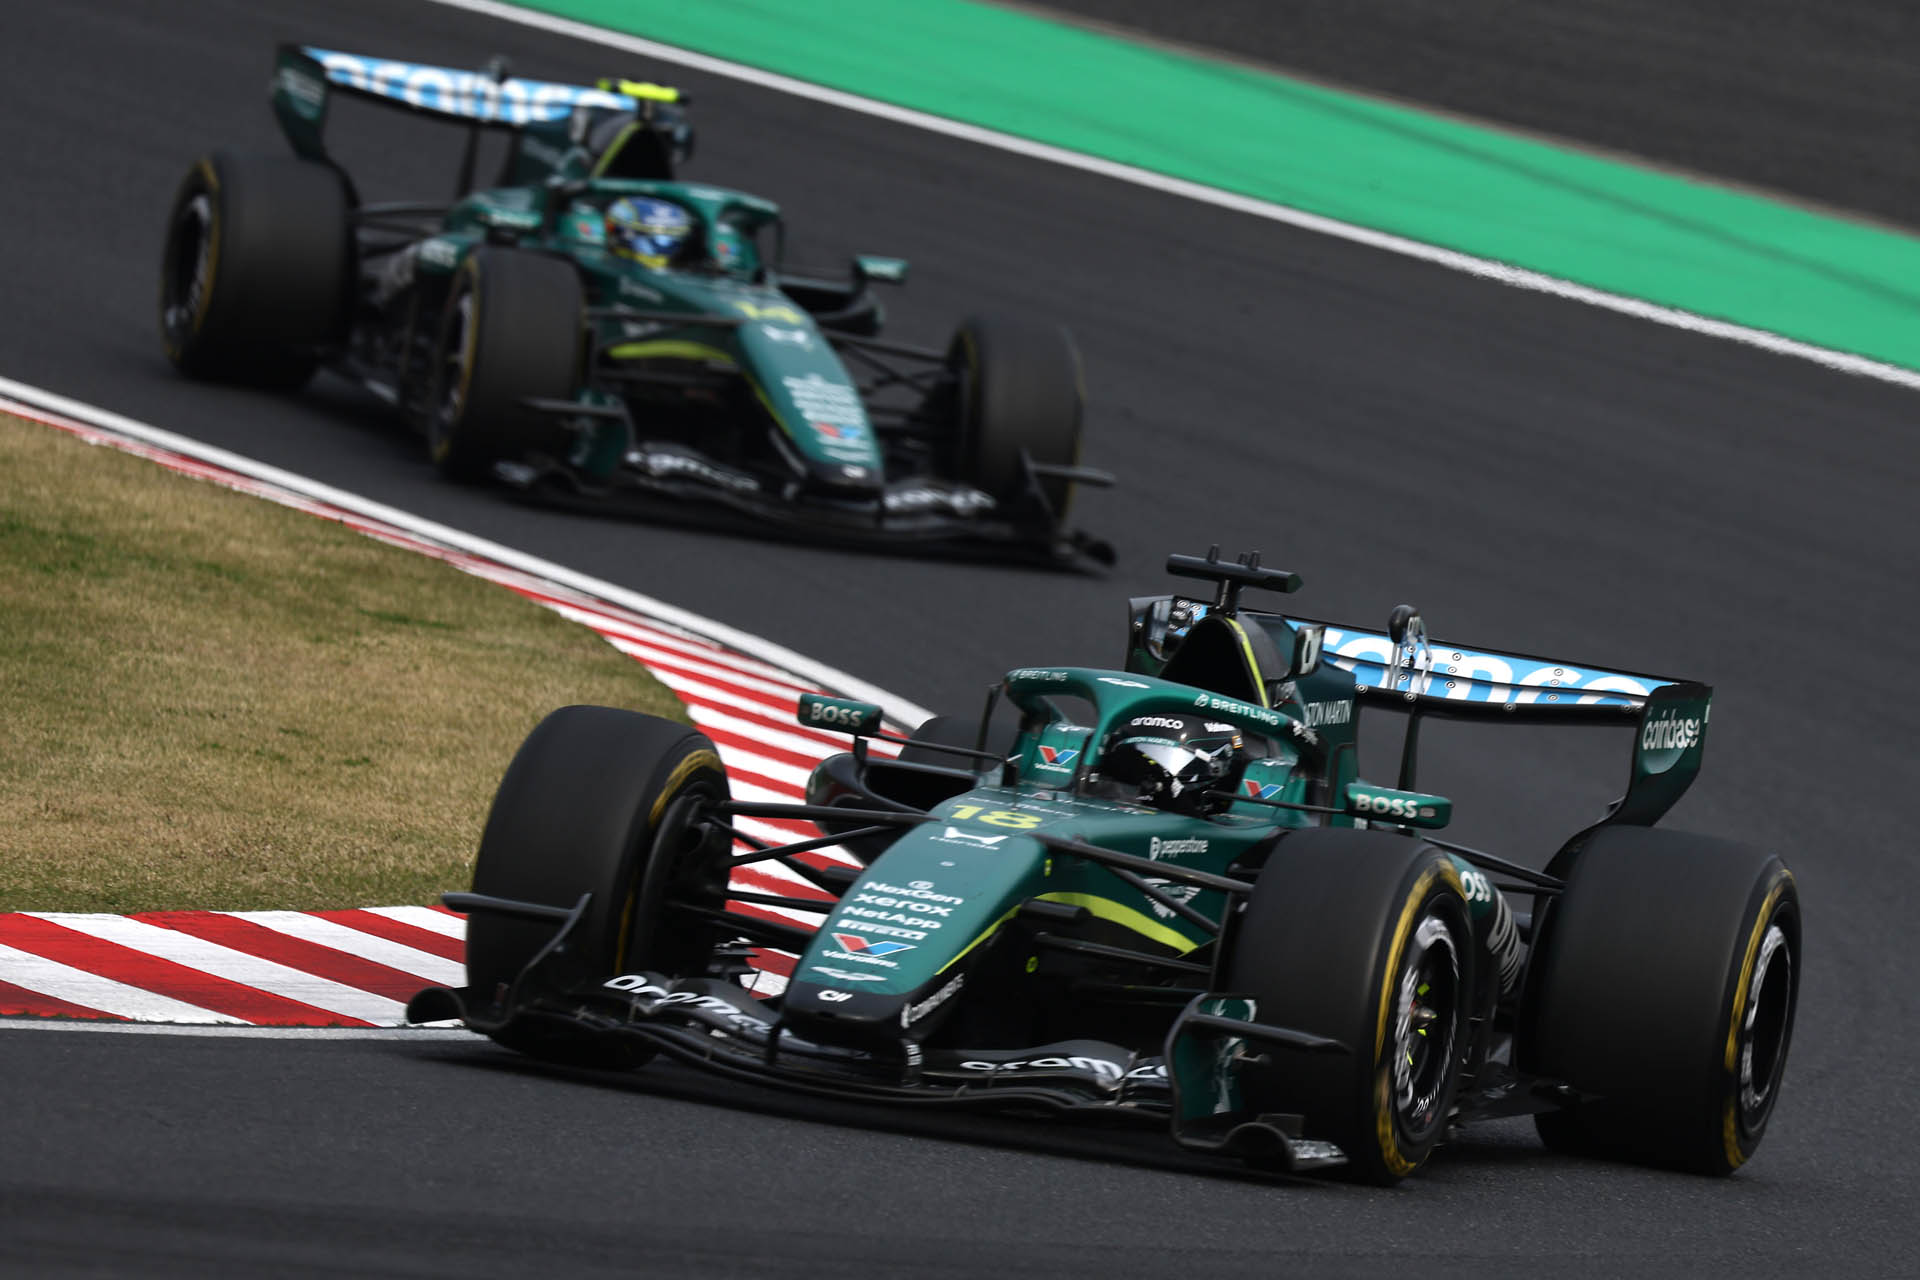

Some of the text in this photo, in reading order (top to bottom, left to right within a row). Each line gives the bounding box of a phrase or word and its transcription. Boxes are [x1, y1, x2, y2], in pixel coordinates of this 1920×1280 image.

[1323, 630, 1650, 707] amco
[810, 702, 863, 727] BOSS
[1131, 716, 1184, 730] aramco
[1210, 698, 1279, 726] BREITLING
[1642, 709, 1700, 750] coinbase
[951, 804, 1043, 829] 18
[1356, 794, 1417, 819] BOSS
[863, 881, 964, 905] NexGen
[1460, 871, 1491, 903] OSS
[841, 905, 942, 929] NetApp
[852, 893, 953, 917] xerox
